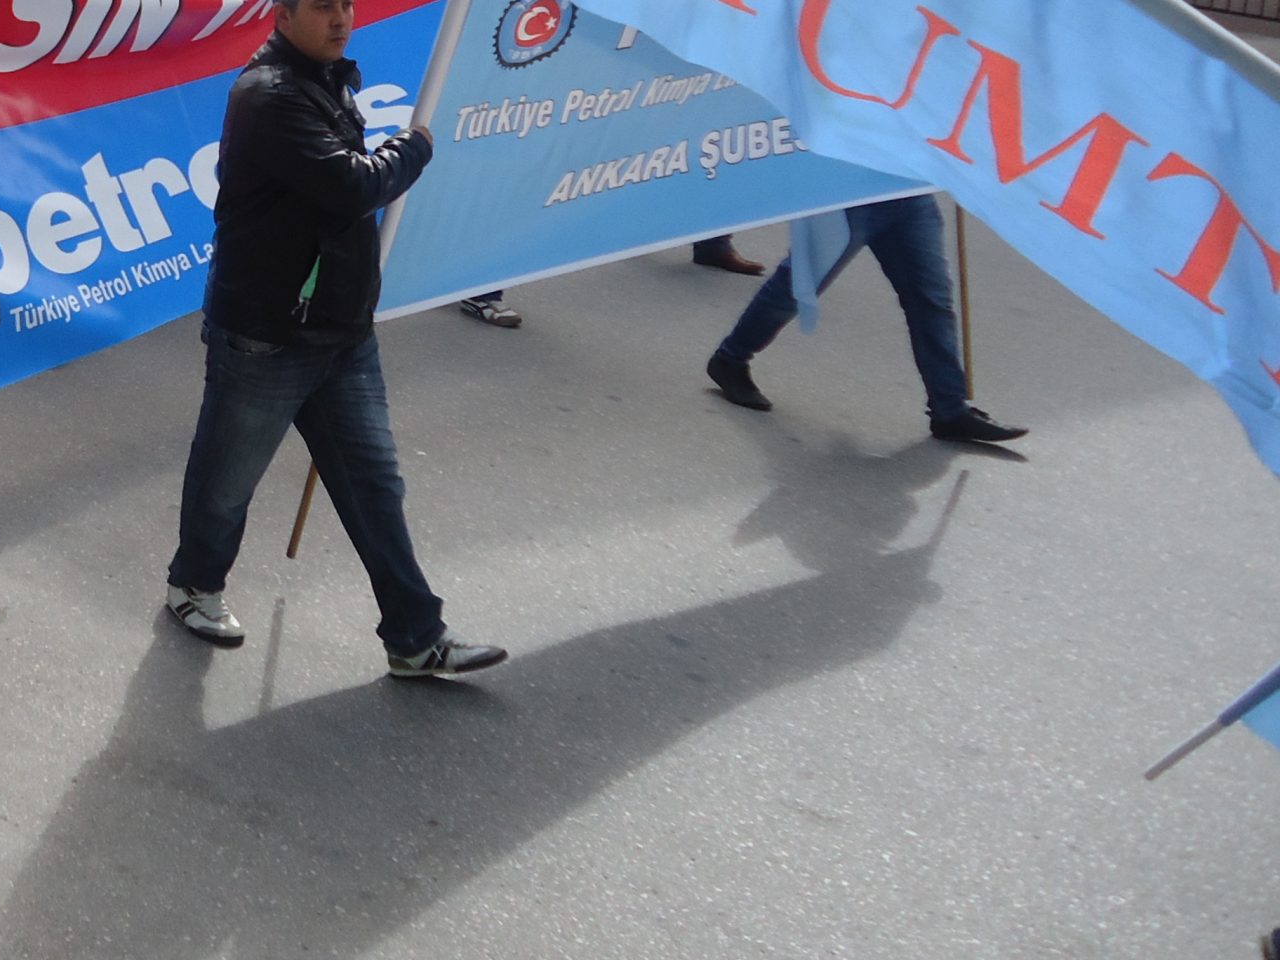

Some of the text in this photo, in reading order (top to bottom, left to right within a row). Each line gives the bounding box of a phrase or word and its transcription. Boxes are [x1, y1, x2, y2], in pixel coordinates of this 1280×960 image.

[453, 95, 553, 142] Türkiye
[560, 81, 641, 126] Petrol
[640, 71, 712, 108] Kimya
[543, 140, 689, 208] ANKARA
[10, 292, 81, 333] Türkiye
[77, 274, 133, 314] Petrol
[134, 251, 192, 288] Kimya
